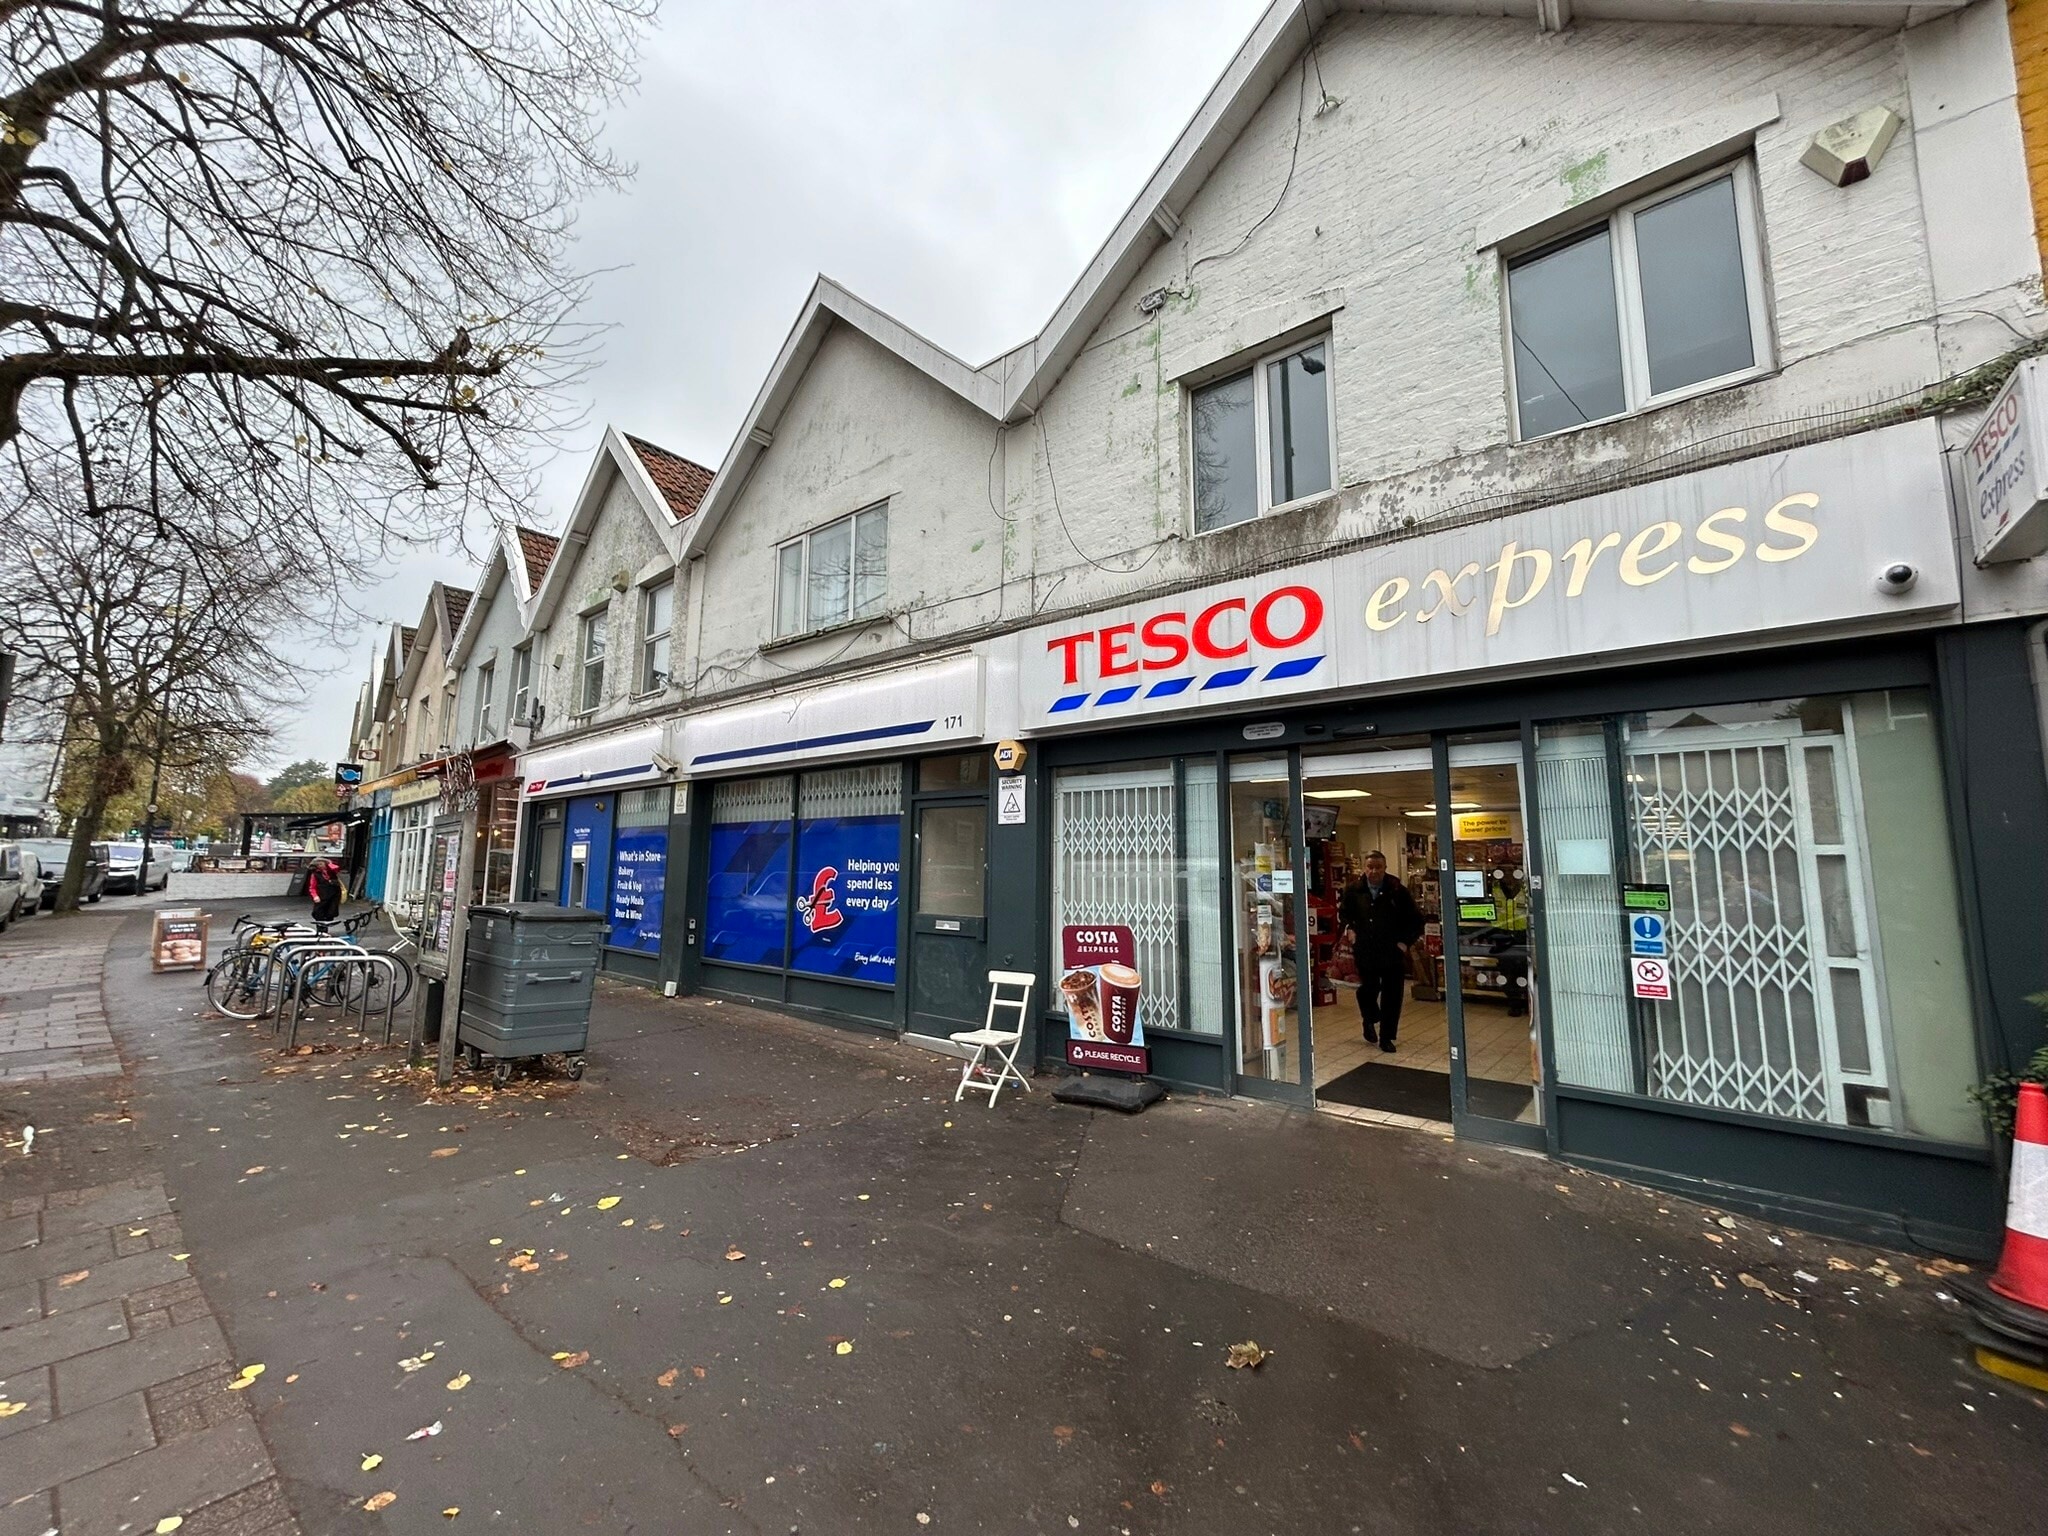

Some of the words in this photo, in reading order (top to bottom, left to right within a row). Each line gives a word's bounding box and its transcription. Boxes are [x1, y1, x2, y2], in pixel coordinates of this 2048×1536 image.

[1972, 393, 2018, 469] TESCO
[1980, 450, 2026, 521] express
[1364, 491, 1820, 638] express
[1047, 585, 1325, 684] TESCO
[944, 715, 963, 729] 171
[1000, 750, 1012, 759] ADT
[619, 850, 638, 862] What's
[639, 850, 645, 862] in
[645, 850, 661, 862] Store
[618, 866, 634, 878] Bakery
[848, 859, 881, 874] Helping
[882, 862, 900, 874] you
[617, 880, 628, 890] Fruit
[633, 881, 642, 893] Veg
[846, 877, 873, 891] spend
[875, 877, 893, 890] less
[616, 894, 630, 906] Ready
[630, 895, 645, 906] Meals
[846, 897, 870, 910] every
[871, 896, 889, 911] day
[630, 909, 642, 921] Wine
[1076, 931, 1119, 945] COSTA
[1083, 945, 1120, 954] EXPRESS
[1112, 995, 1121, 1032] COSTA
[1085, 1050, 1110, 1060] PLEASE
[1110, 1053, 1141, 1064] RECYCLE
